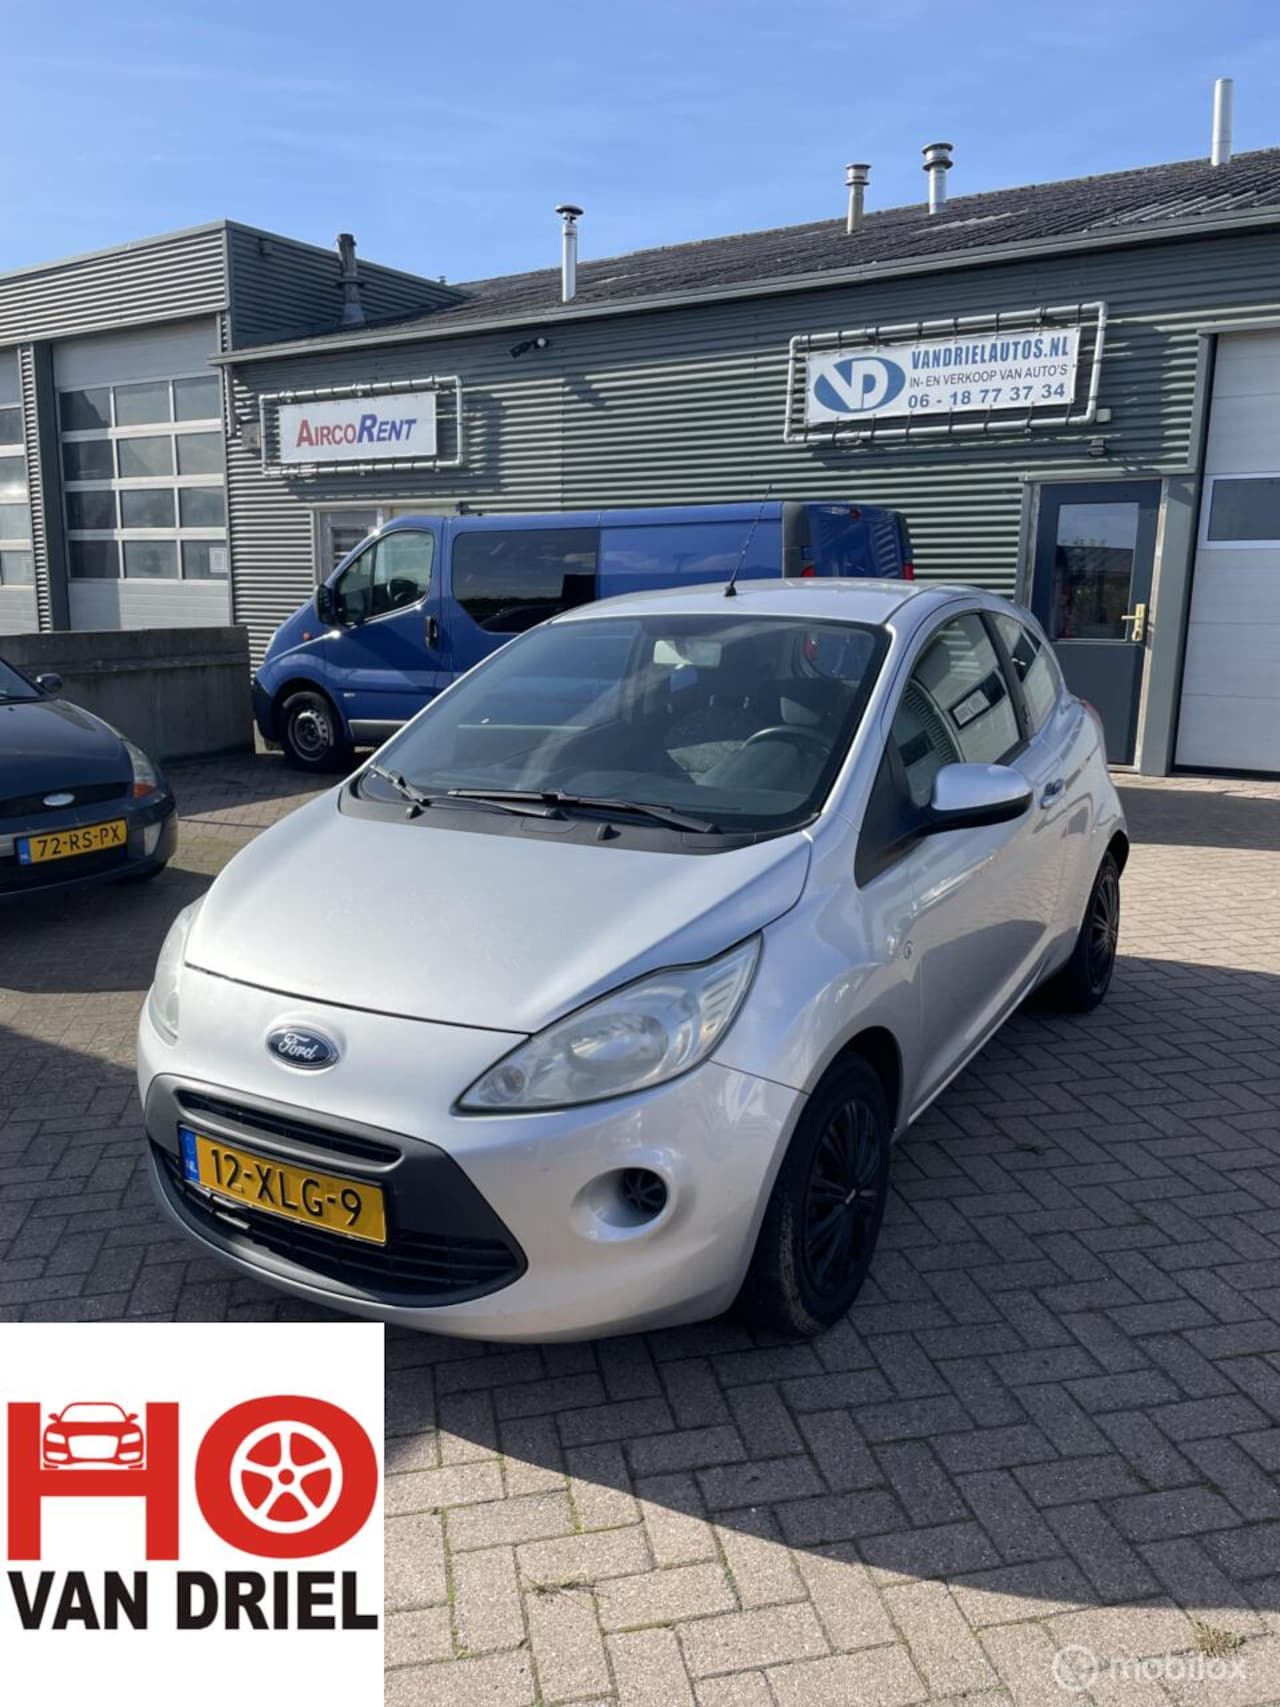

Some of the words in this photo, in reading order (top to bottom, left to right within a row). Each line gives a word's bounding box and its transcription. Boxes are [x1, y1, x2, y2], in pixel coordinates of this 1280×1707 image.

[911, 336, 1069, 370] VANDRIELAUTOS.NL
[909, 376, 924, 389] IN-
[926, 375, 940, 387] EN
[943, 369, 997, 385] VERKOOP
[999, 366, 1022, 381] VAN
[1023, 363, 1068, 379] AUTO'S
[908, 393, 930, 409] 06
[950, 390, 971, 406] 18
[979, 388, 1002, 403] 77
[1009, 385, 1034, 401] 37
[1041, 383, 1066, 399] 34
[36, 824, 121, 857] 72-RS-PX
[278, 1032, 319, 1060] Ford
[210, 1148, 362, 1227] 12-XLG-9
